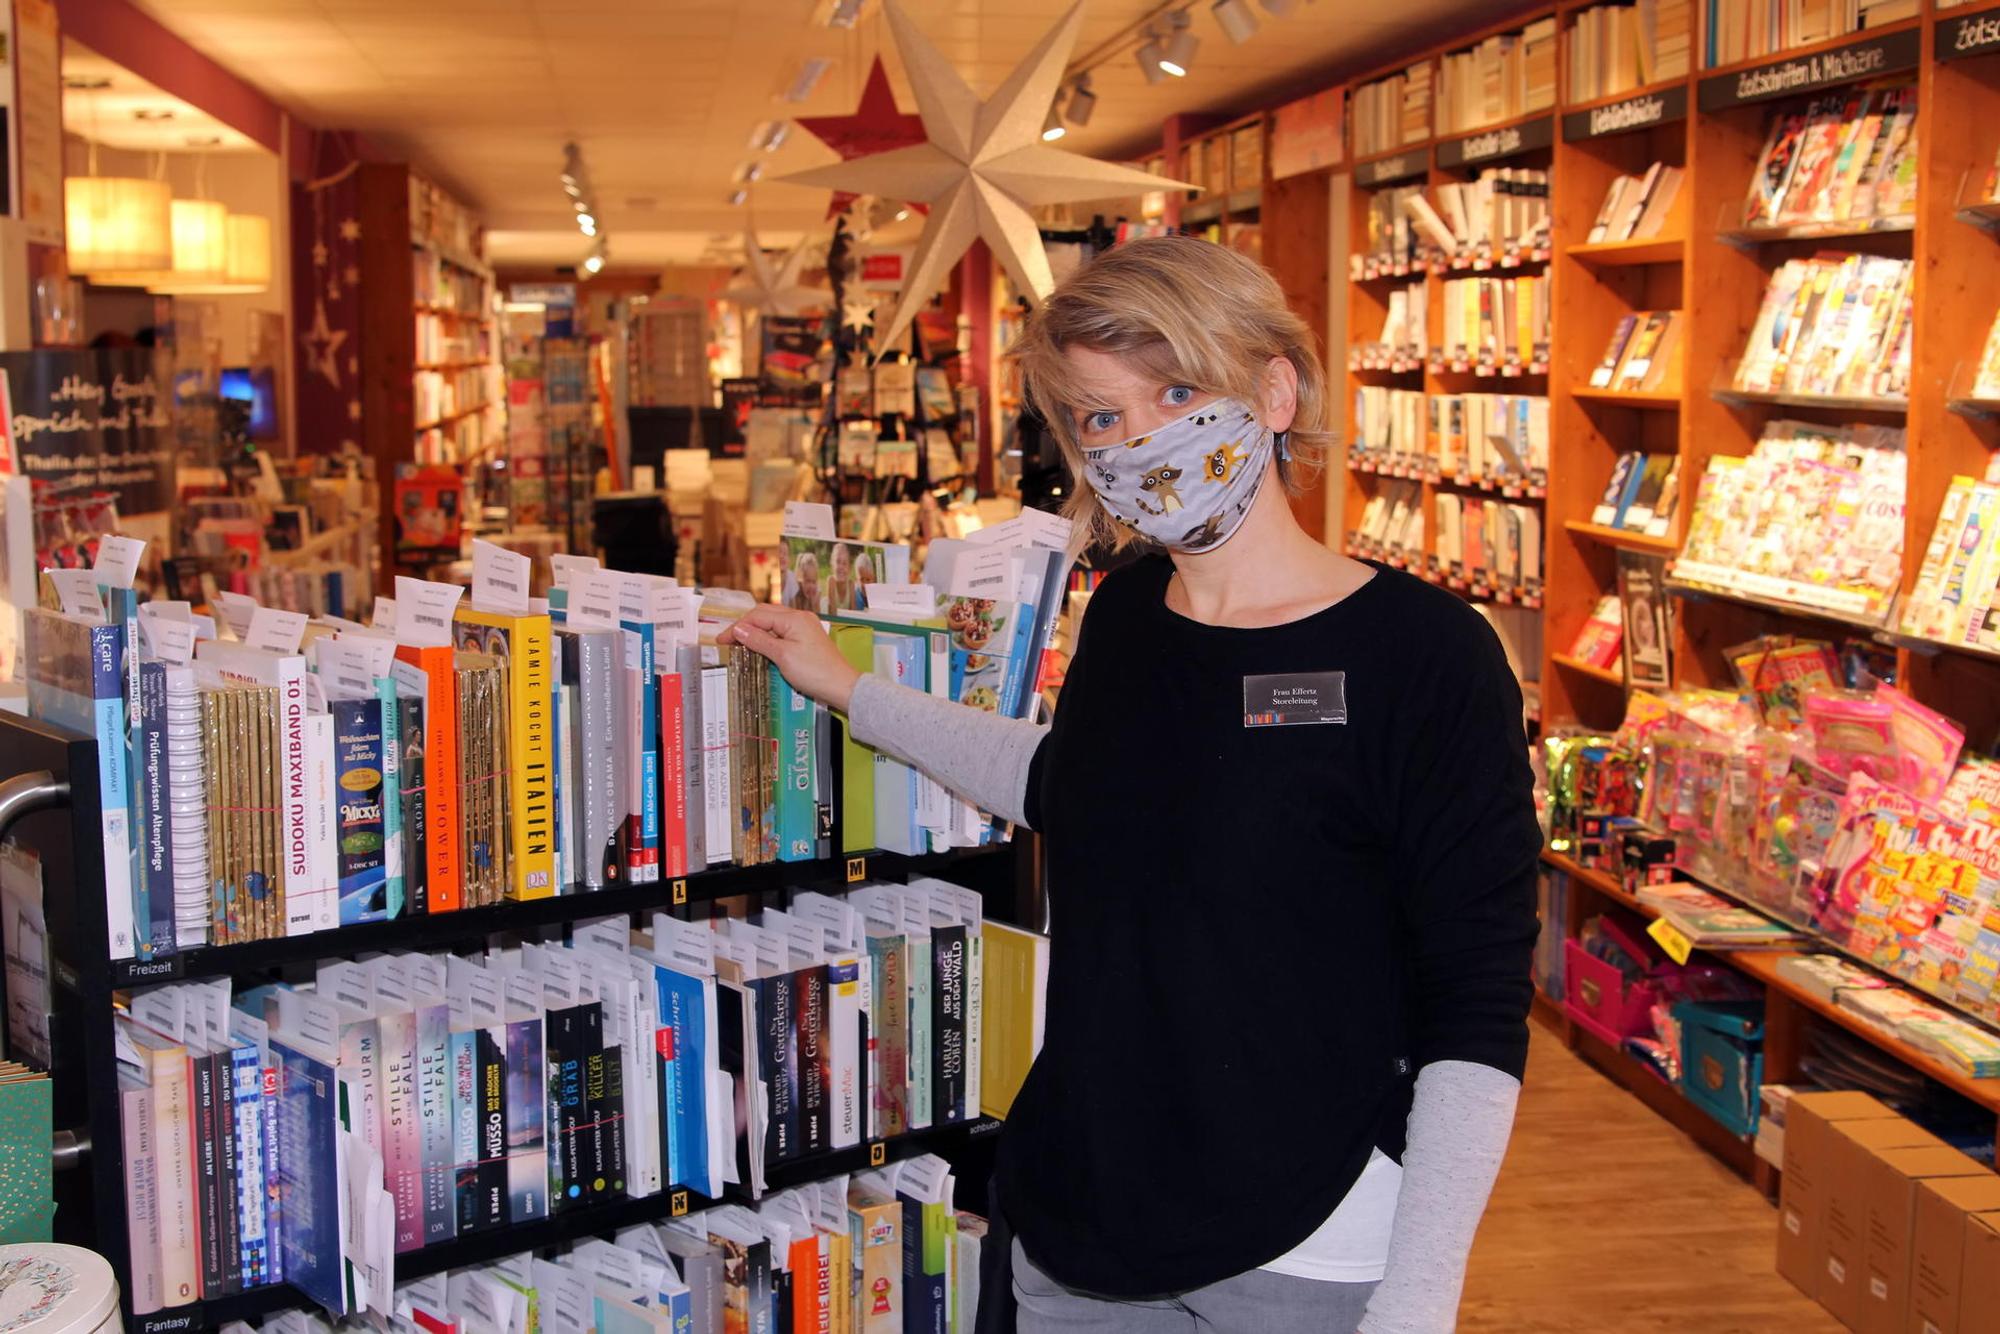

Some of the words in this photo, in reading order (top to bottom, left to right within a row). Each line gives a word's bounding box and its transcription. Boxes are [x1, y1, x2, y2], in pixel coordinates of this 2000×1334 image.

[528, 637, 540, 688] JAMIE
[287, 677, 301, 698] 01
[1272, 697, 1318, 706] Storeleitung
[1273, 688, 1290, 697] Frau
[528, 700, 541, 752] KOCHT
[148, 731, 160, 811] Prüfungswissen
[288, 703, 304, 798] MAXIBAND
[606, 756, 614, 796] OBAMA
[414, 792, 424, 842] CROWN
[527, 763, 547, 855] ITALIEN
[607, 800, 615, 846] BARACK
[151, 813, 164, 872] Altenpflege
[291, 804, 305, 876] SUDOKU
[437, 803, 448, 876] POWER
[850, 861, 862, 876] M
[129, 961, 172, 976] Freizeit
[943, 950, 952, 993] JUNGE
[951, 941, 962, 978] WALD
[943, 995, 952, 1014] DER
[953, 979, 961, 1001] DEM
[953, 1002, 961, 1019] AUS
[671, 991, 681, 1045] Schritte
[773, 980, 789, 1062] Götterkriege
[804, 976, 821, 1057] Götterkriege
[402, 1050, 413, 1095] FALL
[434, 1043, 445, 1086] FALL
[943, 1028, 952, 1079] HARLAN
[952, 1031, 961, 1073] COBEN
[223, 1089, 230, 1101] DU
[390, 1063, 402, 1126] STILLE
[423, 1055, 434, 1117] STILLE
[566, 1060, 579, 1106] GRAB
[592, 1054, 604, 1099] KILLER
[203, 1095, 210, 1106] DU
[462, 1107, 474, 1159] MUSSO
[490, 1113, 502, 1158] MUSSO
[206, 1165, 213, 1176] AN
[226, 1158, 233, 1169] AN
[674, 1194, 686, 1212] N
[400, 1232, 413, 1242] LYX
[431, 1223, 445, 1232] LYX
[818, 1253, 830, 1296] IRRE!
[145, 1316, 190, 1333] Fantasy
